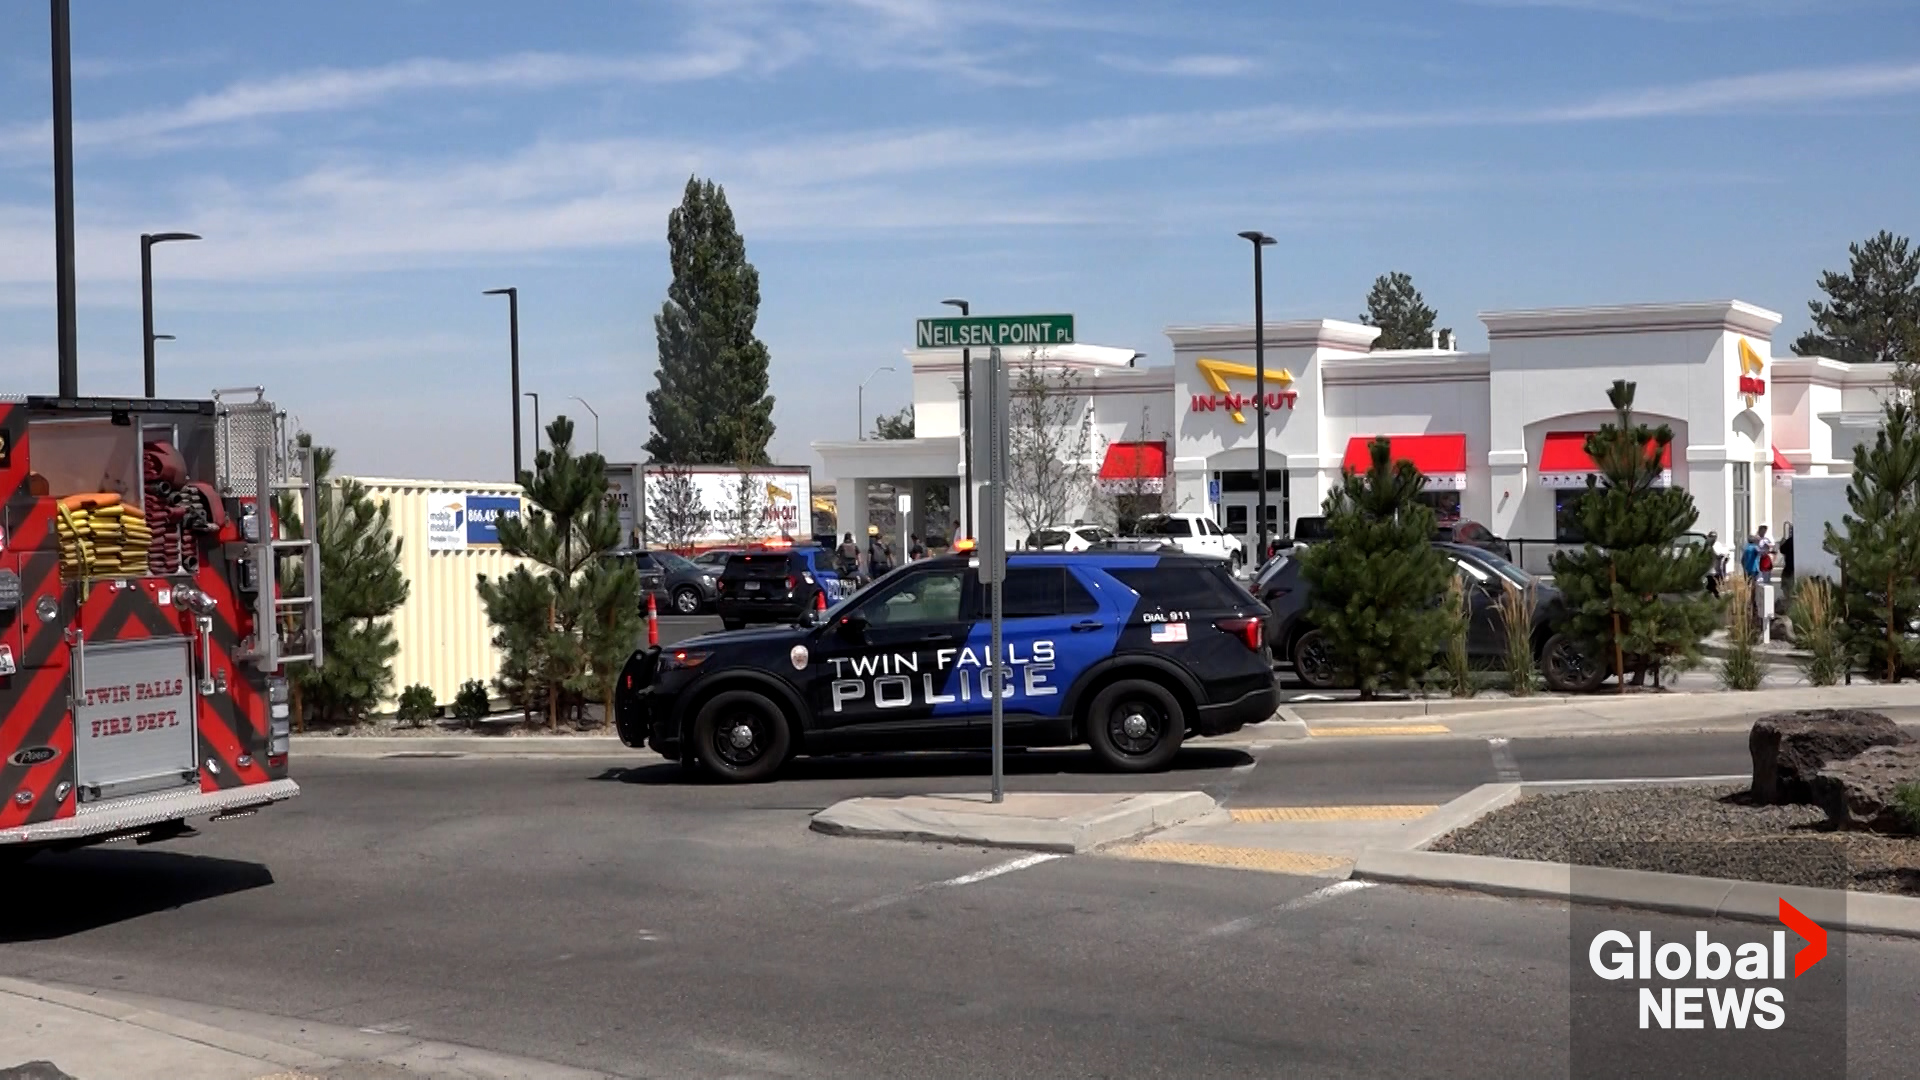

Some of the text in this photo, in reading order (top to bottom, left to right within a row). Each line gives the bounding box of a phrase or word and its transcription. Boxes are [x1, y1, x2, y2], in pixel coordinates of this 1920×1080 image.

[919, 321, 1073, 346] NEILSEN POINT PL
[1192, 392, 1297, 412] IN-N-OUT
[1143, 611, 1190, 623] DIAL 911
[827, 640, 1055, 678] TWIN FALLS
[85, 679, 183, 706] TWIN FALLS
[832, 663, 1058, 712] POLICE
[91, 714, 133, 738] FIRE
